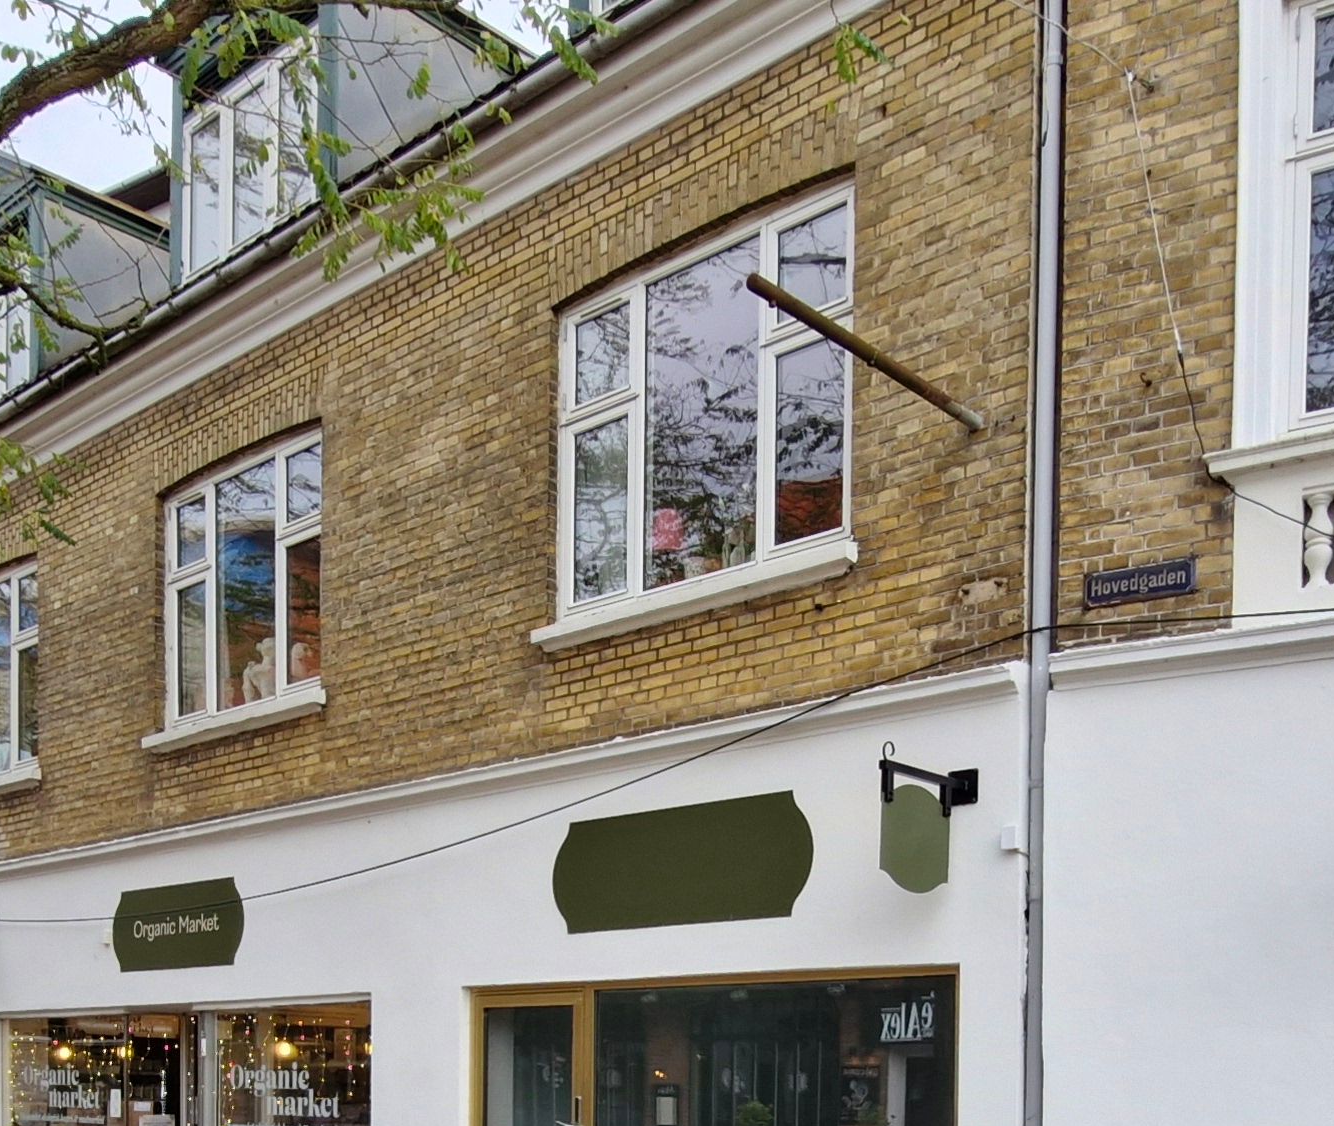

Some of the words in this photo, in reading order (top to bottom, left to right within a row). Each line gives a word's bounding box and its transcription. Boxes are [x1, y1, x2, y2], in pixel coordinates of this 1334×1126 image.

[1090, 568, 1187, 598] Hovedgaden
[133, 916, 176, 942] Organic
[178, 912, 220, 934] Market
[23, 1064, 80, 1091] Organic
[229, 1062, 310, 1097] Organic
[49, 1084, 103, 1109] market
[266, 1089, 340, 1118] market
